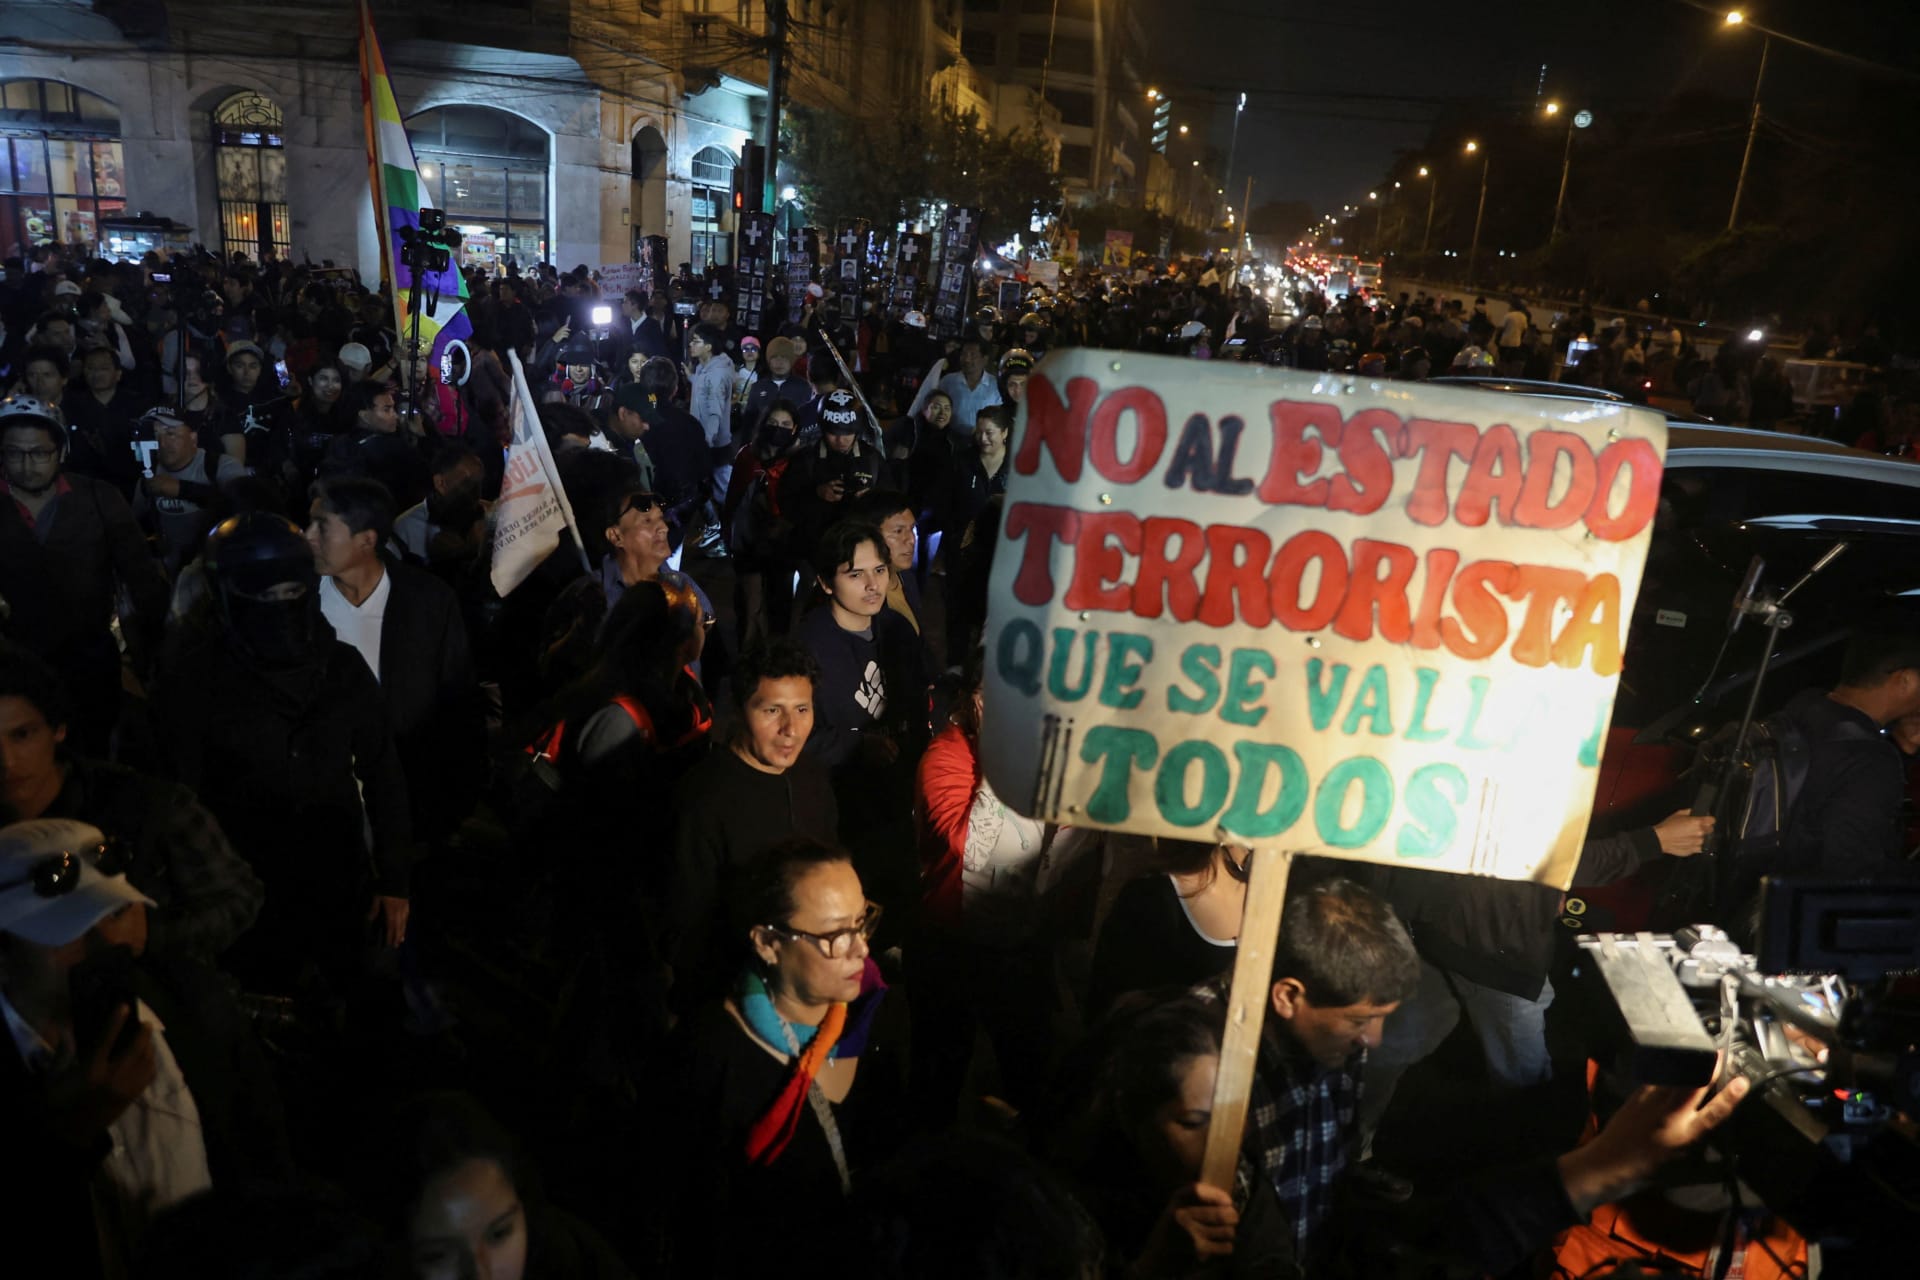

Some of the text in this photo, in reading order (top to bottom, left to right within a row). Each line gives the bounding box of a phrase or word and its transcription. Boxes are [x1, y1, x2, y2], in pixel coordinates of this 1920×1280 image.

[824, 409, 857, 424] PRENSA
[1015, 373, 1664, 543] NO AL ESTADO
[1005, 502, 1624, 677] TERRORISTA
[998, 619, 1152, 710] QUE
[1166, 644, 1276, 727] SE
